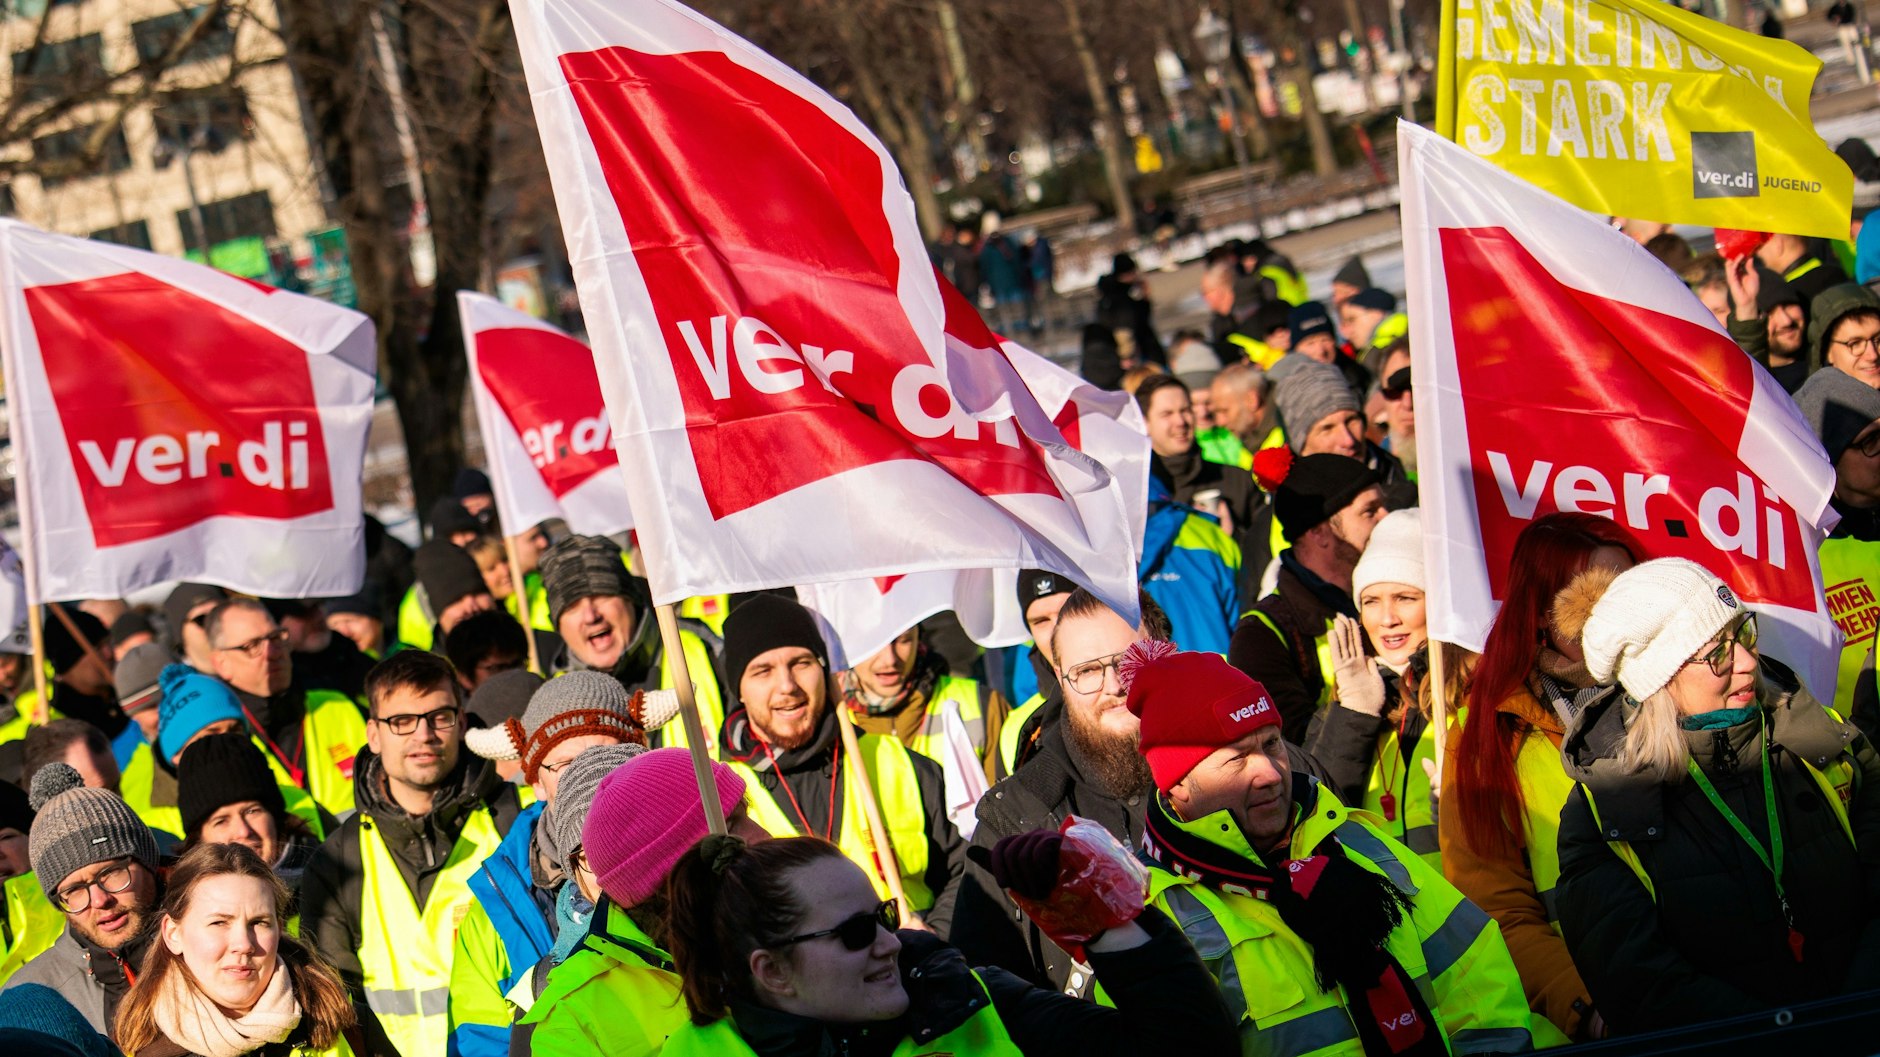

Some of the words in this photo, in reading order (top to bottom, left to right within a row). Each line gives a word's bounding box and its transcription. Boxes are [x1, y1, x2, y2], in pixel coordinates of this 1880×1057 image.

[1464, 73, 1676, 162] STARK
[1697, 170, 1754, 189] ver.di
[1763, 176, 1822, 193] JUGEND
[78, 421, 310, 490] ver.di
[1486, 450, 1786, 570] ver.di
[1229, 696, 1270, 723] ver.di
